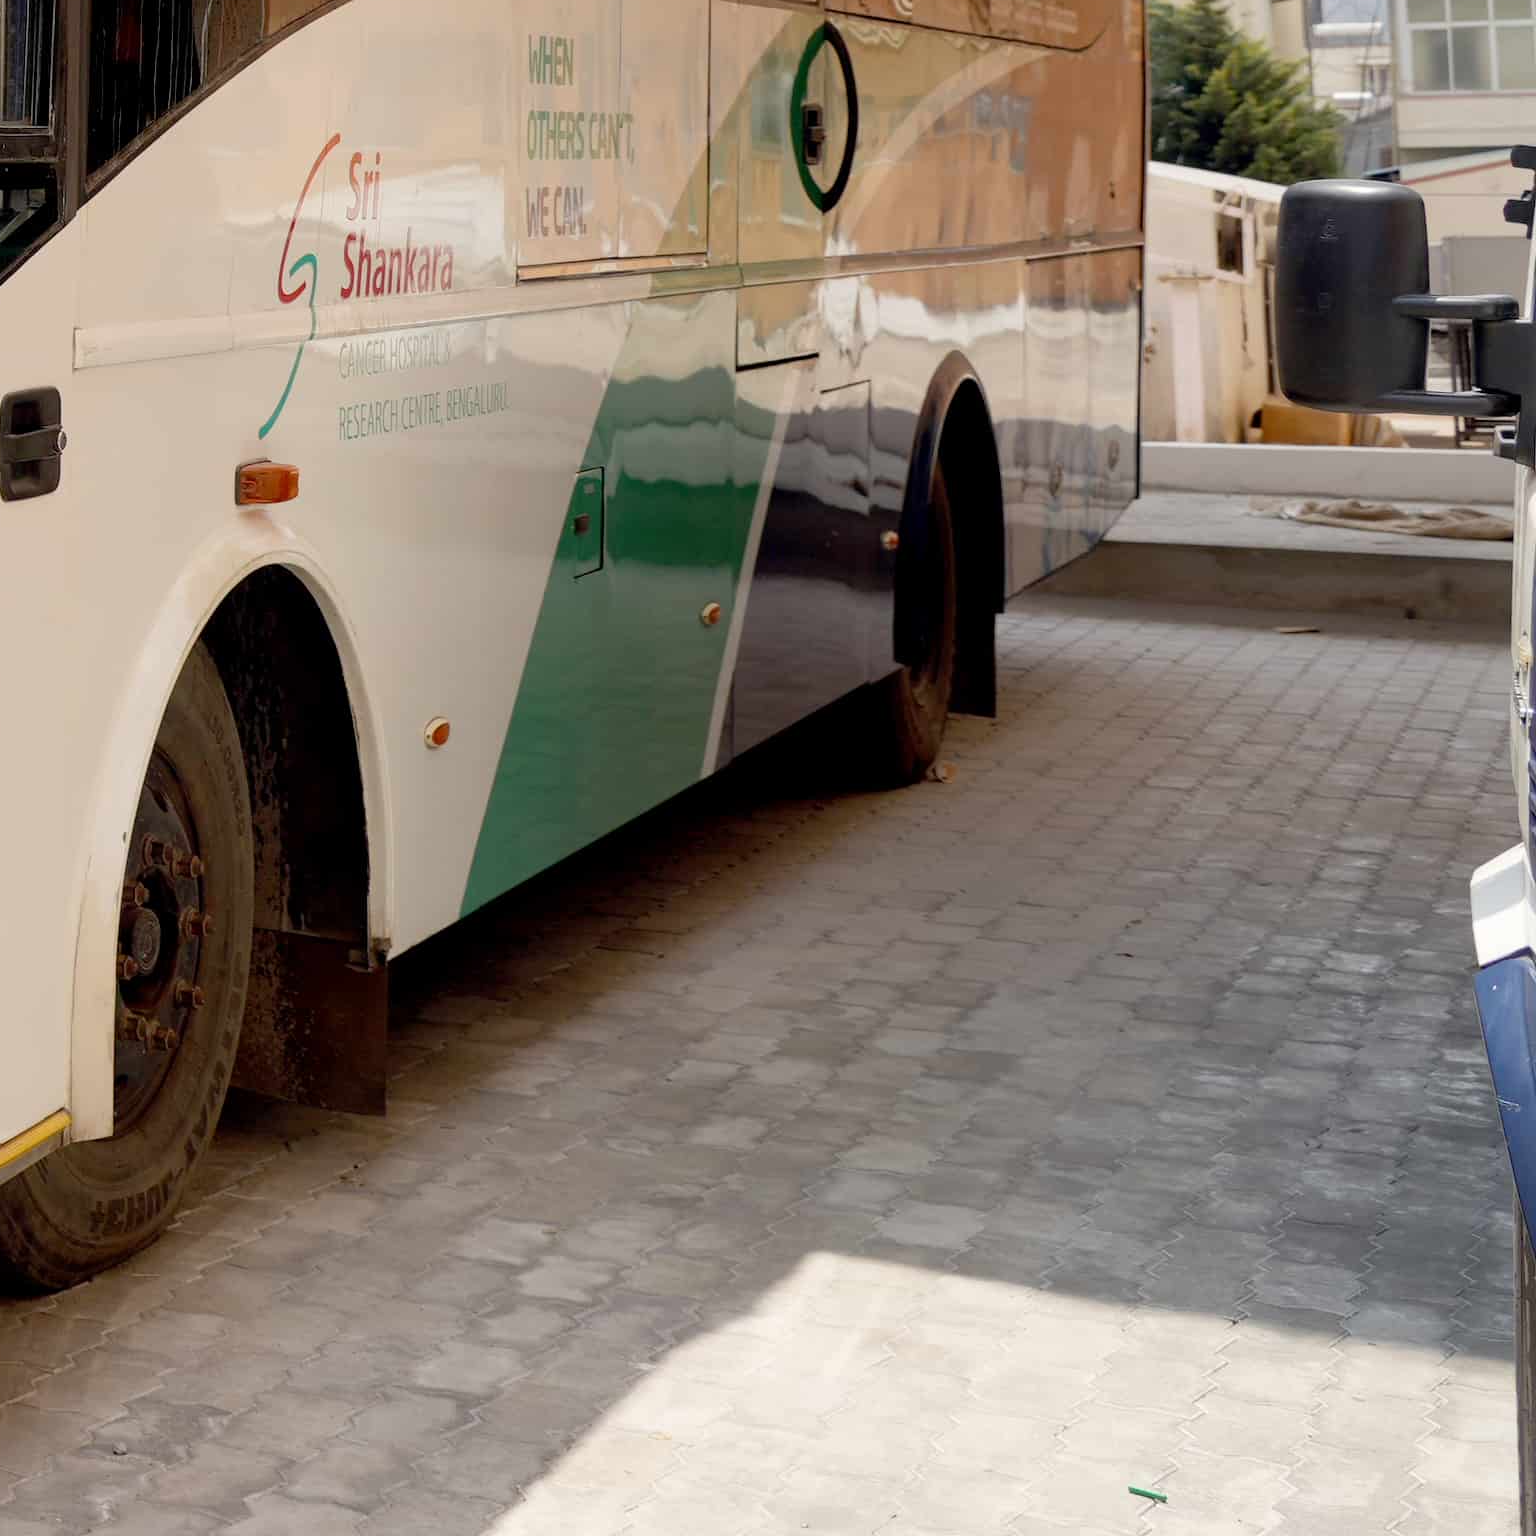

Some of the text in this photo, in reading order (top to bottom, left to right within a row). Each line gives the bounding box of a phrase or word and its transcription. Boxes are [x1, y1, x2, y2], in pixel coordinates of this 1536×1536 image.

[528, 34, 575, 85] WHEN
[527, 110, 584, 160] OTHERS
[345, 151, 382, 221] Sri
[526, 186, 587, 237] WE CAN.
[340, 226, 454, 300] Shankara
[339, 340, 387, 378] CANCER
[390, 334, 442, 368] HOSPITAL
[339, 400, 398, 440] RESEARCH
[402, 392, 444, 429] CENTRE,
